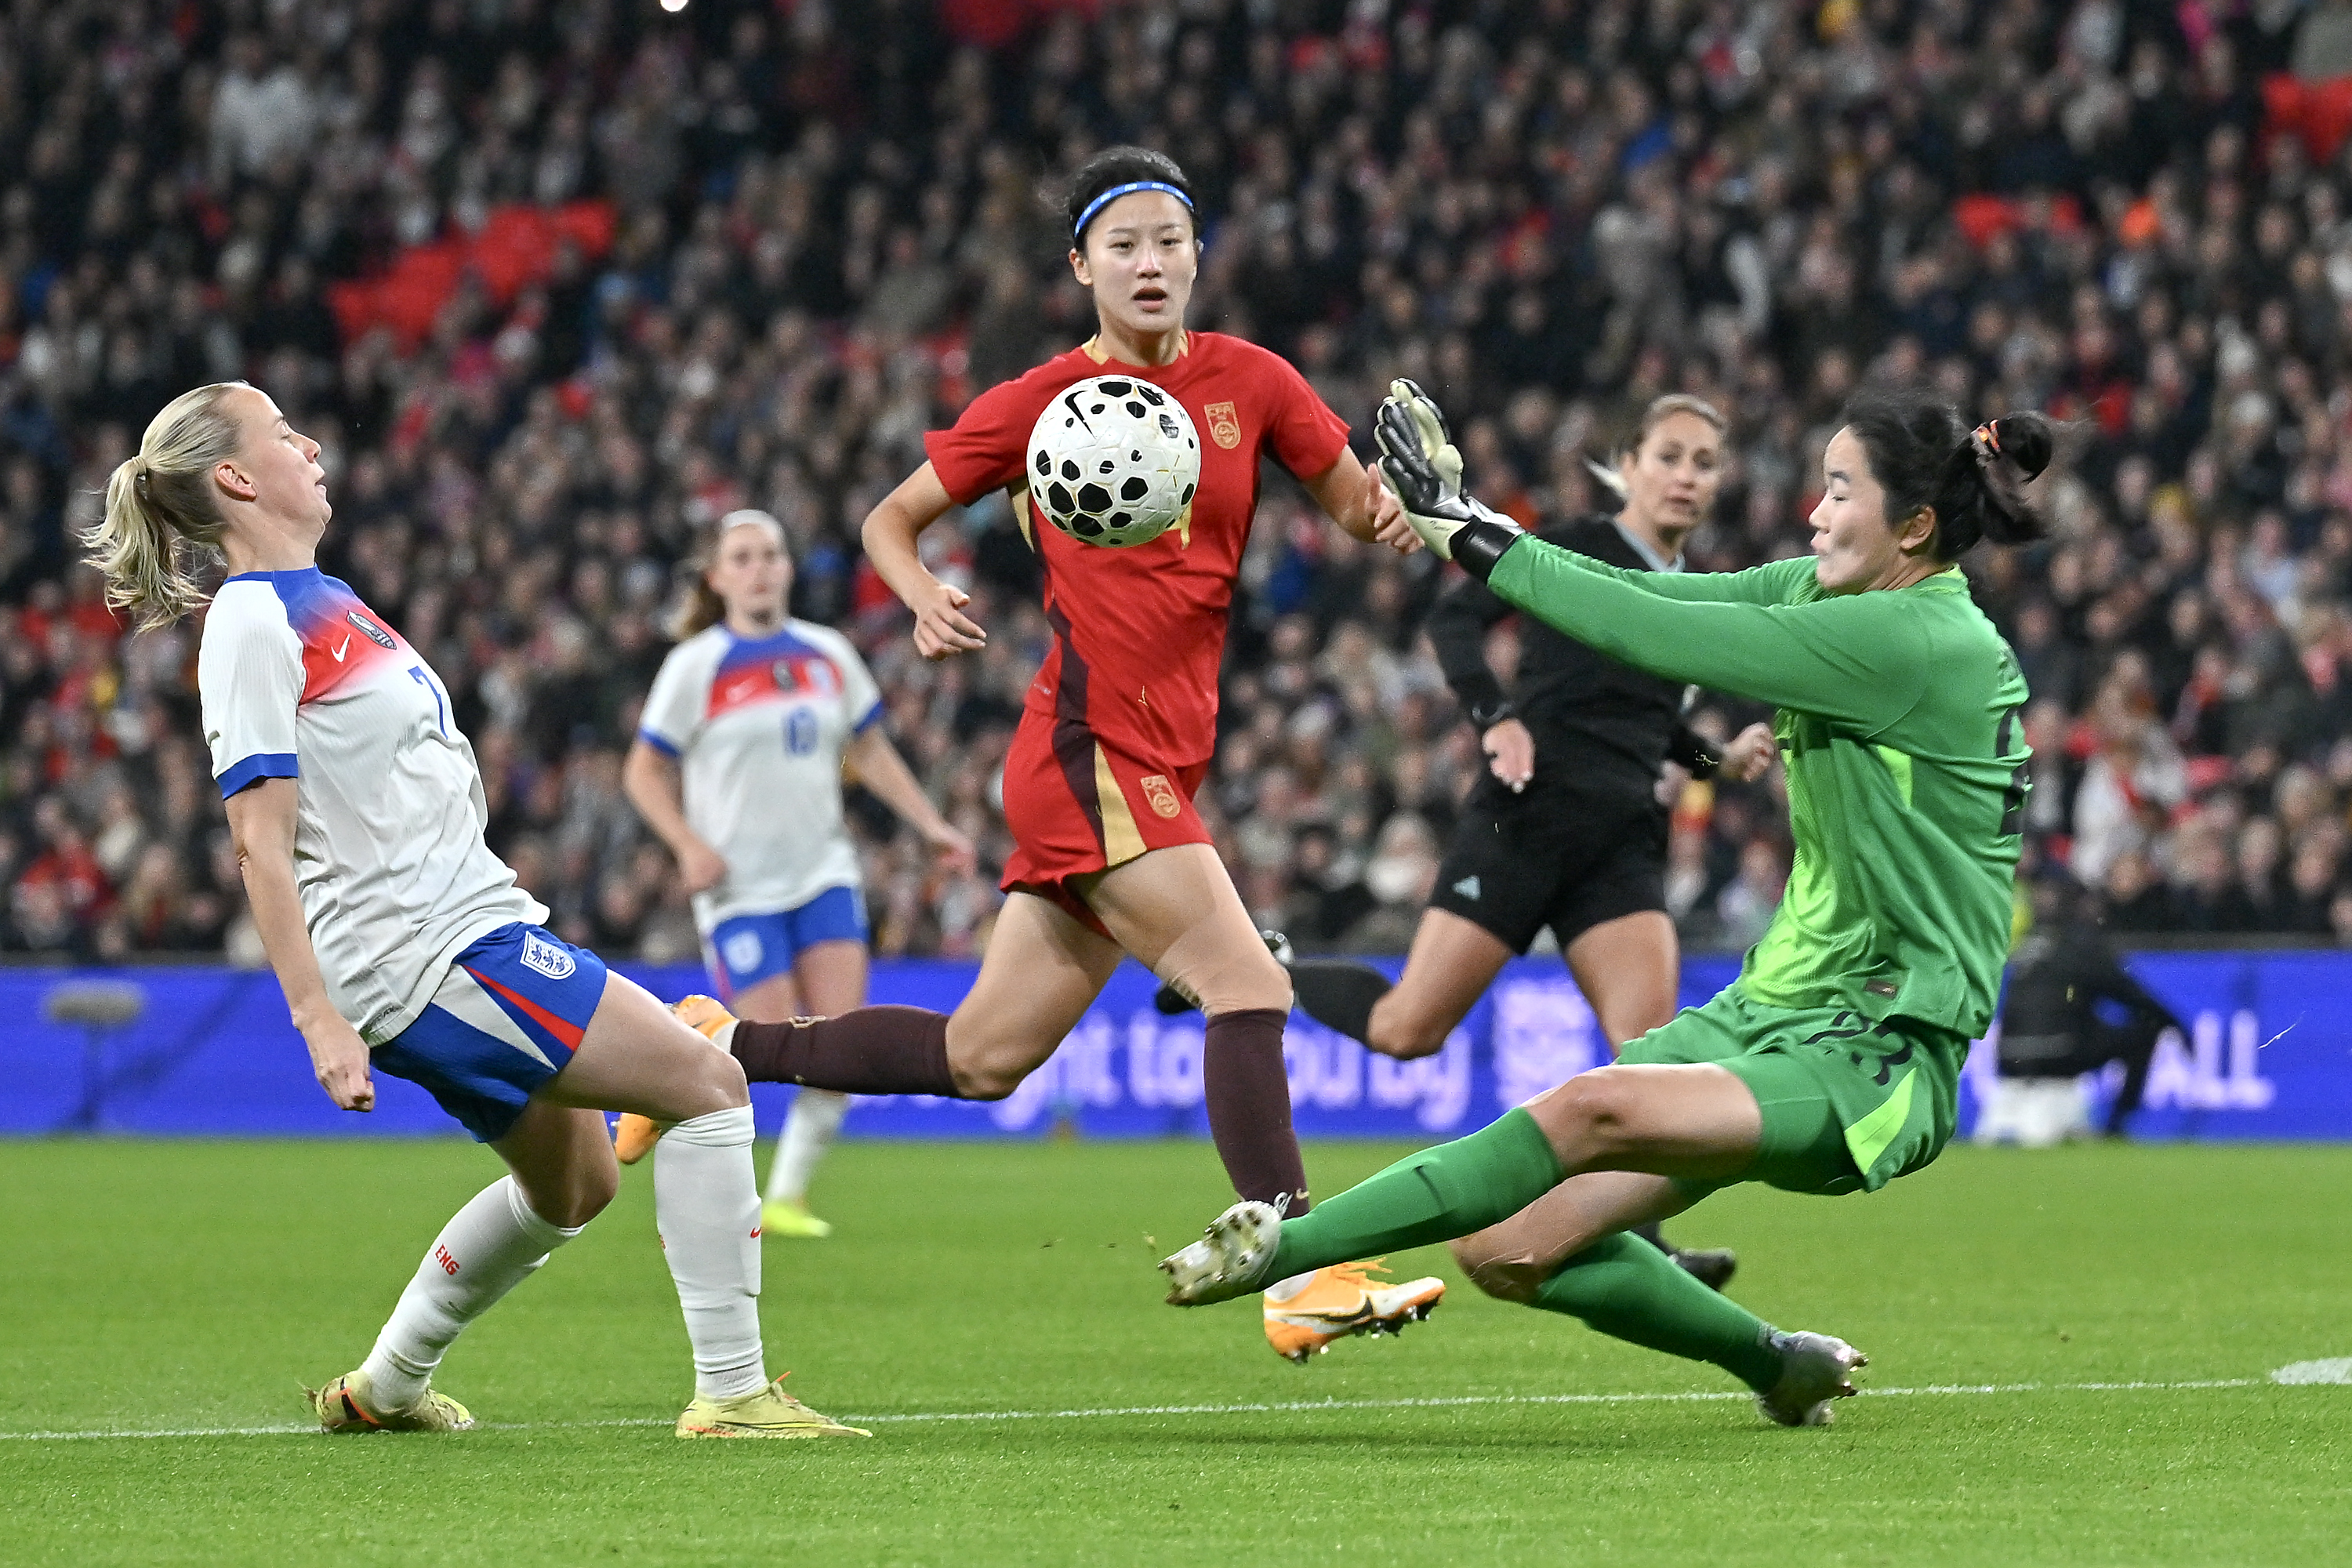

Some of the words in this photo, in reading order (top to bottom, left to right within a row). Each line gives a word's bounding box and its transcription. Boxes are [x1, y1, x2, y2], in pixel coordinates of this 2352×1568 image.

[407, 665, 448, 740] 7
[1130, 1011, 1206, 1107] to
[1283, 1025, 1364, 1108] ou
[1797, 1010, 1914, 1087] 23
[2142, 1010, 2275, 1109] ALL
[435, 1243, 460, 1276] ENG
